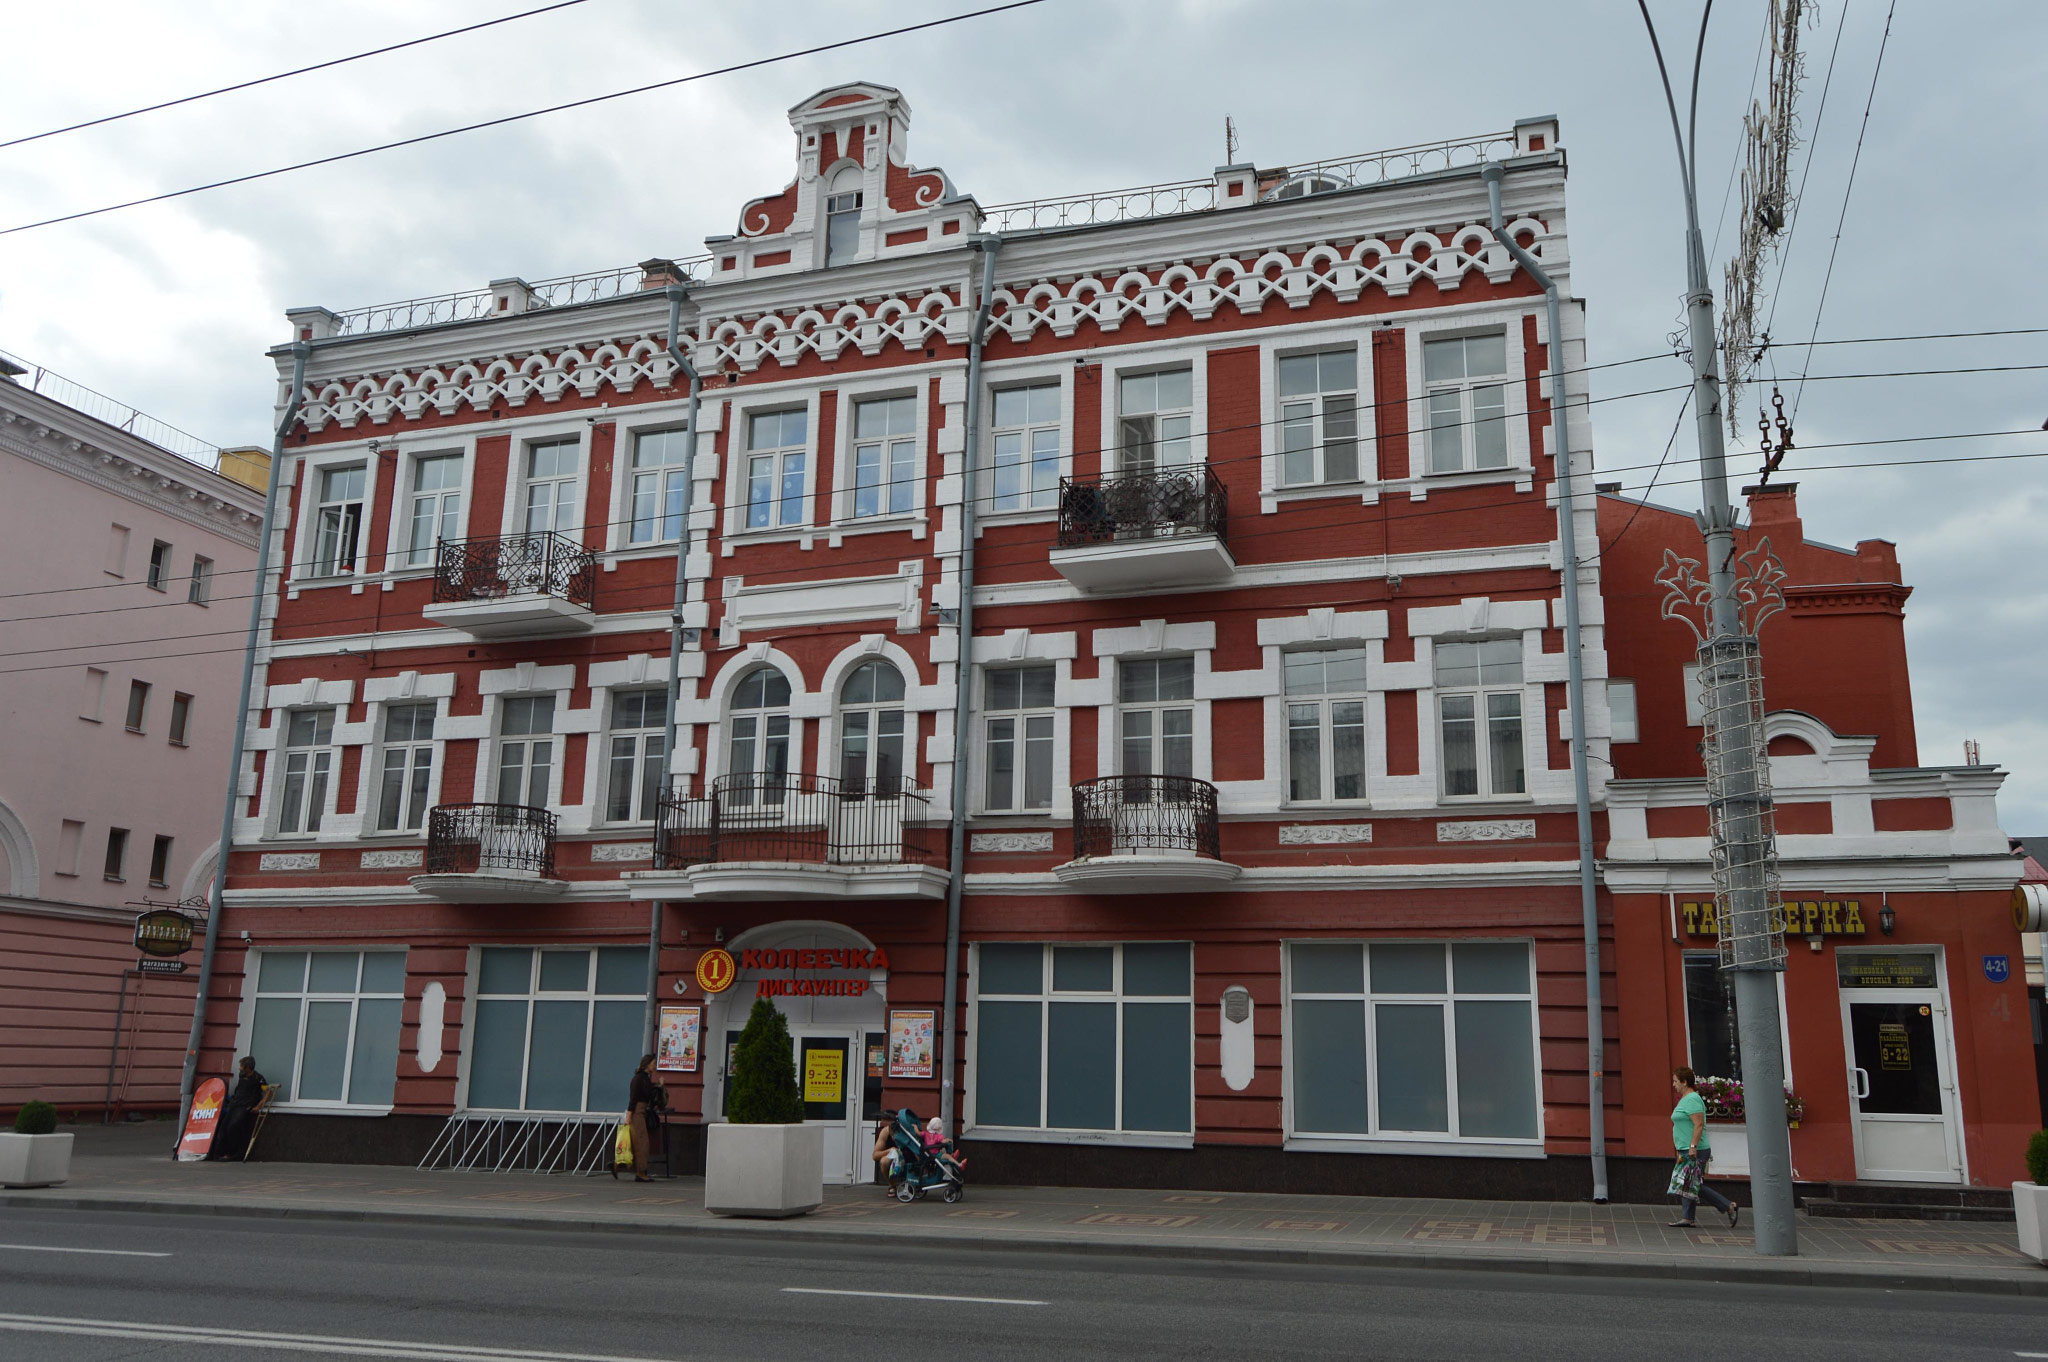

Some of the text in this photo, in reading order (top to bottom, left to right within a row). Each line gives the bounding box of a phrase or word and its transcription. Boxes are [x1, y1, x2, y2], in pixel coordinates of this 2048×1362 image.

[1682, 901, 1865, 934] ТАЕРКА
[741, 947, 890, 970] КОПЕЕЧКА
[709, 958, 720, 980] 1
[1986, 959, 2007, 973] 4-21
[1861, 976, 1892, 984] ВКУСНЫЙ
[756, 979, 870, 998] ДИСКАУНТЕР
[1882, 1048, 1889, 1061] 9
[1896, 1048, 1908, 1061] 22
[808, 1069, 815, 1079] 9
[825, 1069, 838, 1079] 23
[192, 1107, 218, 1120] КИНГ
